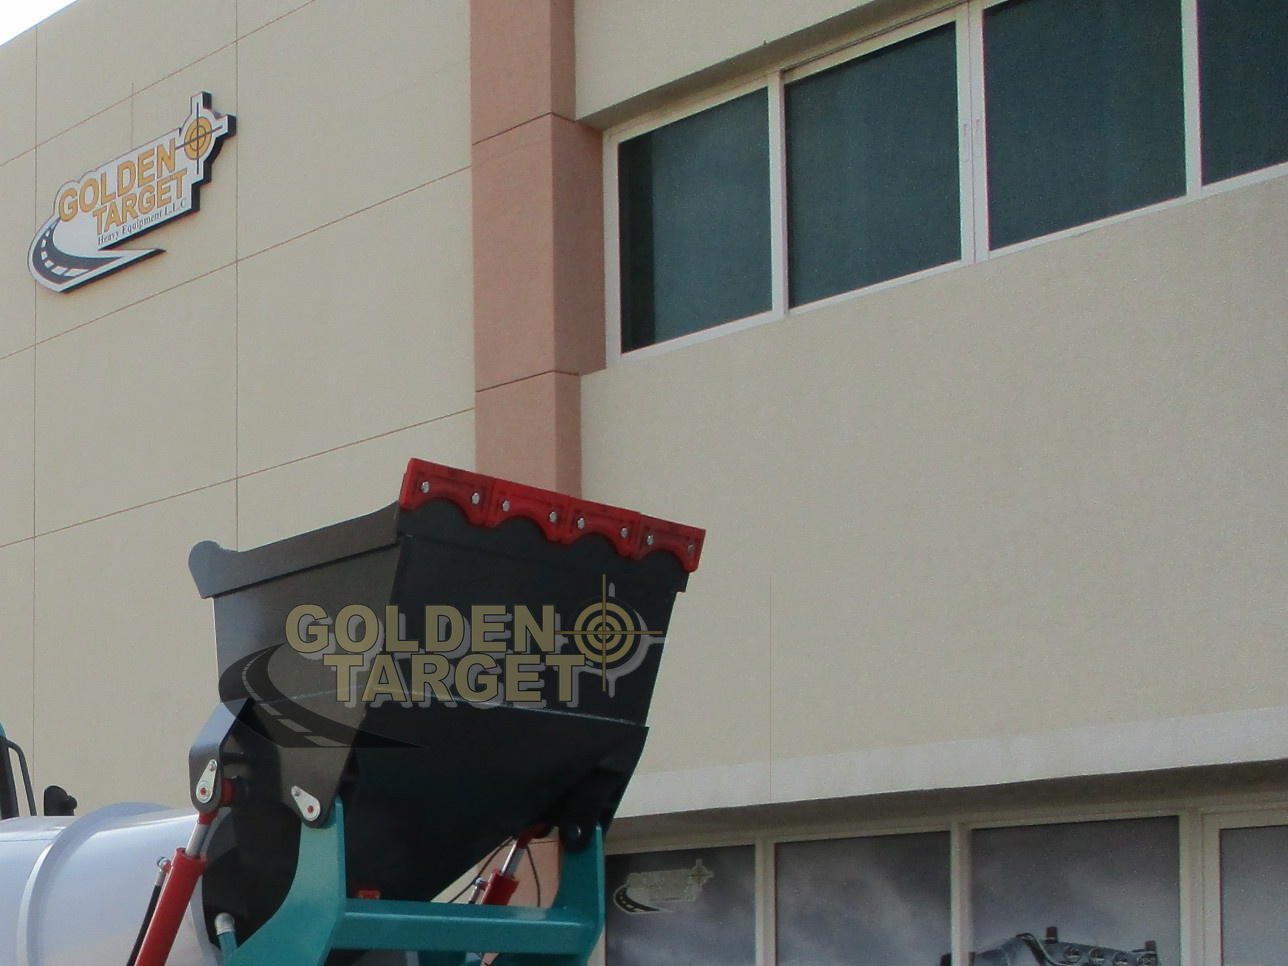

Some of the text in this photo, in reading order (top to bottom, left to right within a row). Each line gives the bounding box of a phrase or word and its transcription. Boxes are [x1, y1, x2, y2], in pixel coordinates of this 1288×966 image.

[58, 138, 176, 221] GOLDEN
[92, 167, 187, 235] TARGET
[97, 230, 120, 246] Heavy
[122, 211, 162, 235] Equipment
